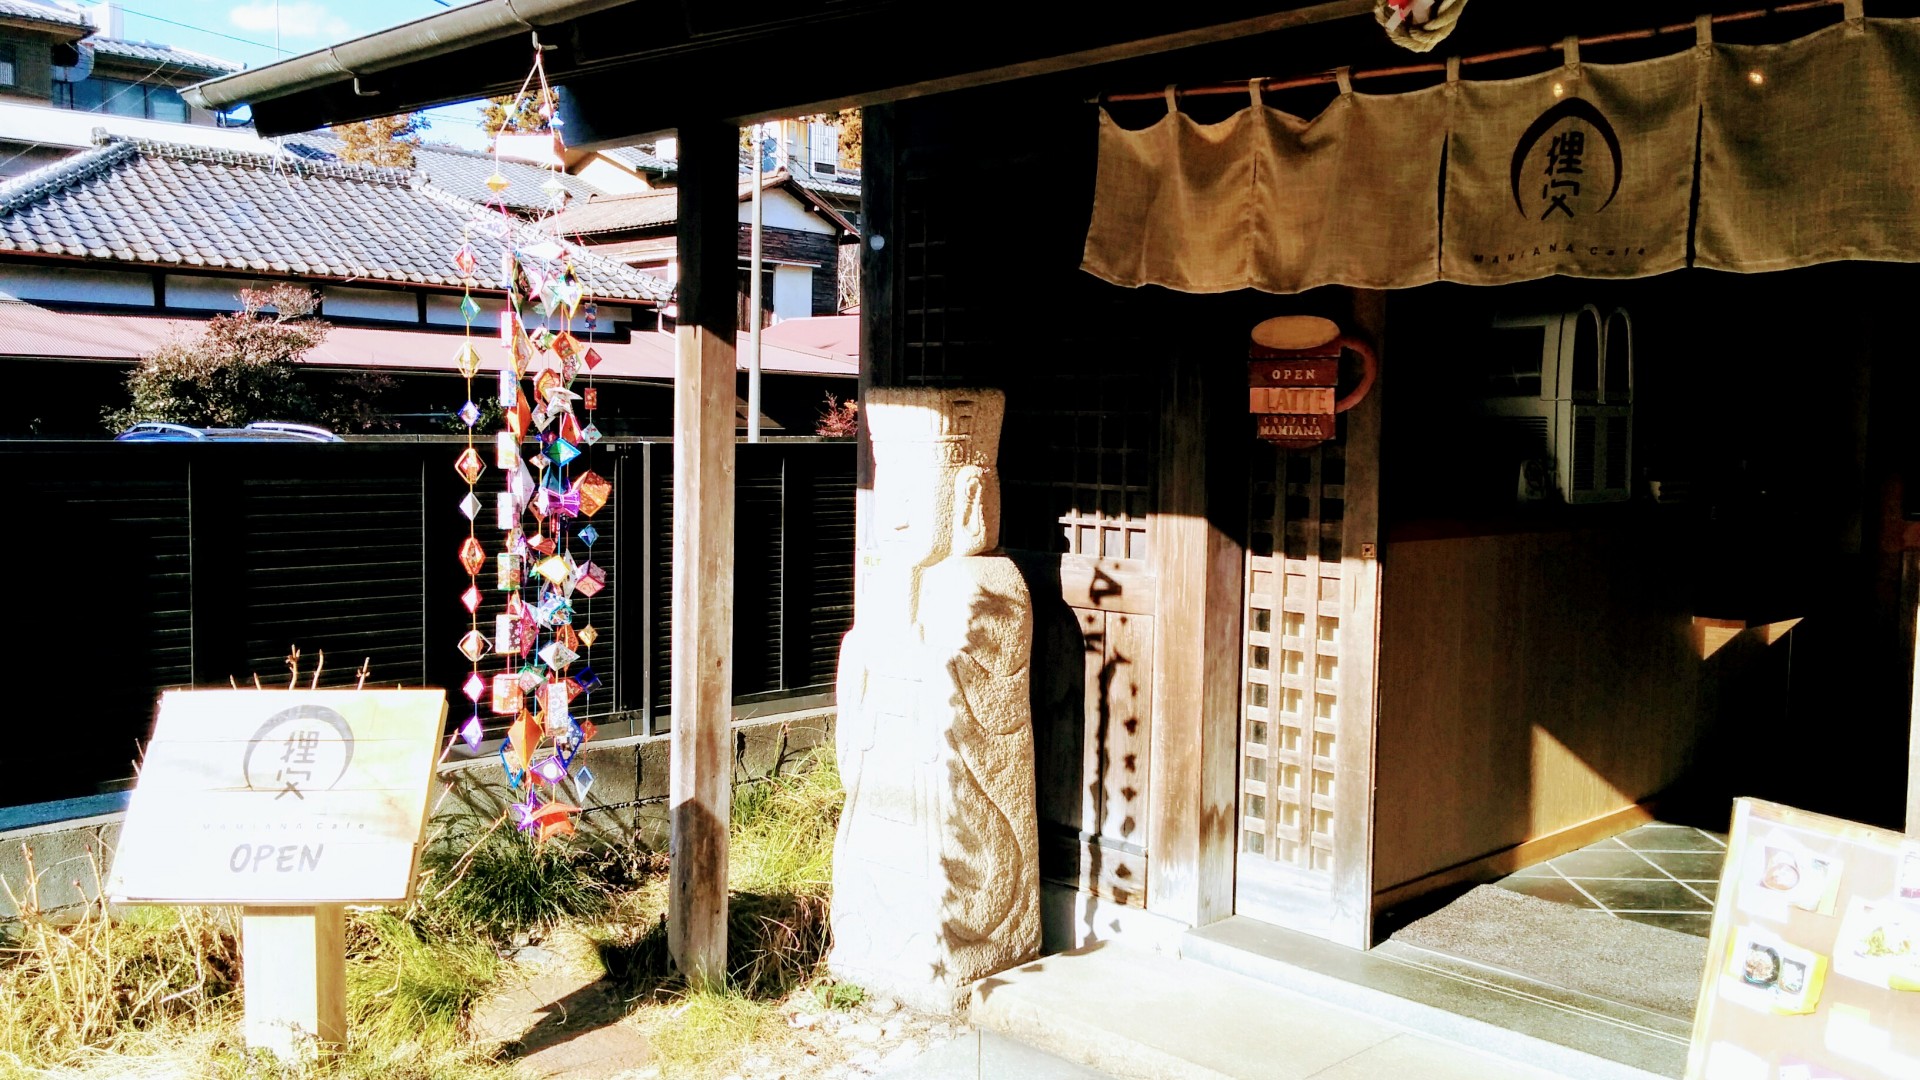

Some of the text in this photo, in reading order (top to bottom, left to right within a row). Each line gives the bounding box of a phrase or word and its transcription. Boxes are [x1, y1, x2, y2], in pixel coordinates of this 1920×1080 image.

[1589, 246, 1646, 257] Cafe
[1271, 369, 1316, 380] OPEN
[1262, 388, 1327, 411] LATTE
[1264, 417, 1318, 425] COFFEE
[1259, 425, 1323, 436] MAMIANA
[316, 822, 365, 830] Cafe
[229, 843, 324, 874] OPEN
